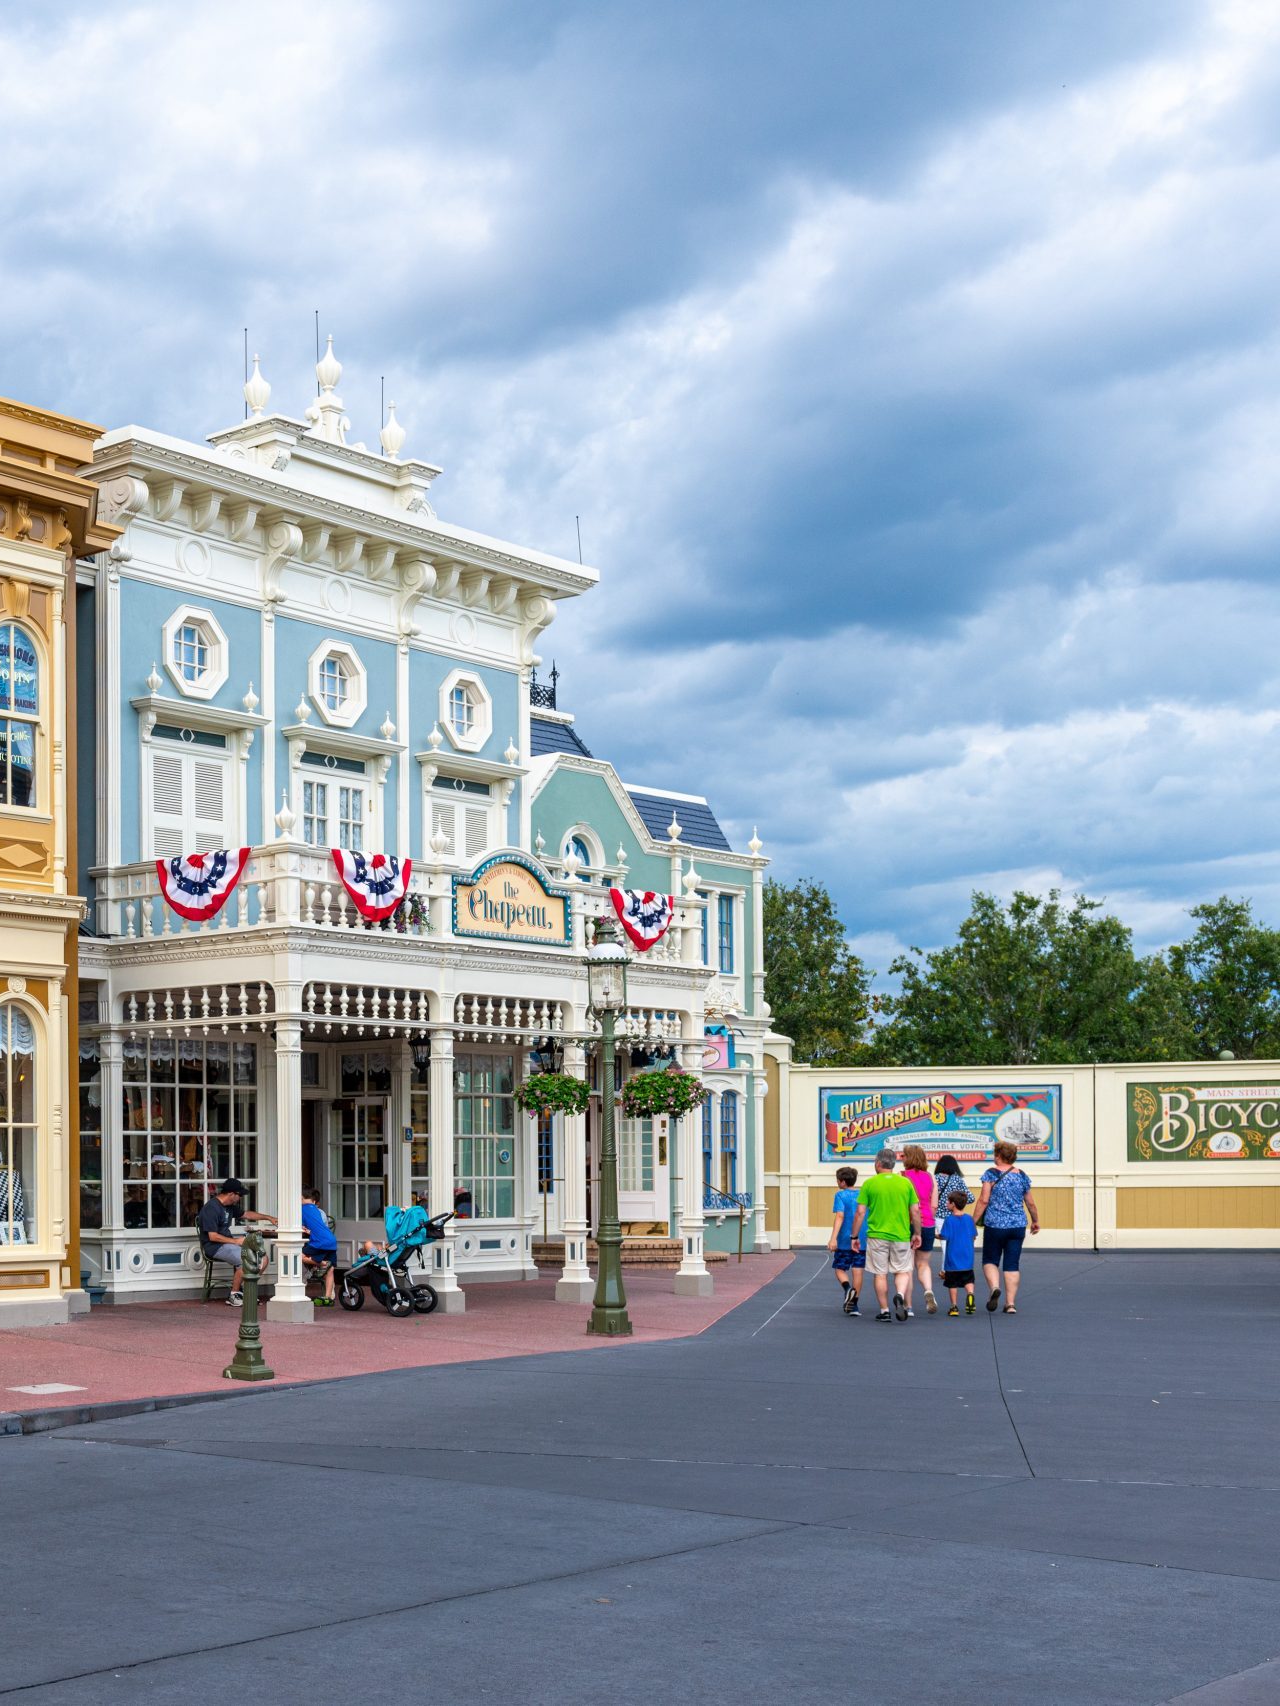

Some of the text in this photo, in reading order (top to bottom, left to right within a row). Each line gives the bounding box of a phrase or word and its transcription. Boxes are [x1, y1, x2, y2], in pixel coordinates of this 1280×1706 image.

[504, 881, 519, 899] the
[1206, 1089, 1235, 1098] MAIN
[840, 1093, 883, 1121] RIVER
[834, 1094, 947, 1153] EXCURSIONS
[892, 1132, 928, 1141] PASSENGERS
[960, 1133, 987, 1141] ASSURED
